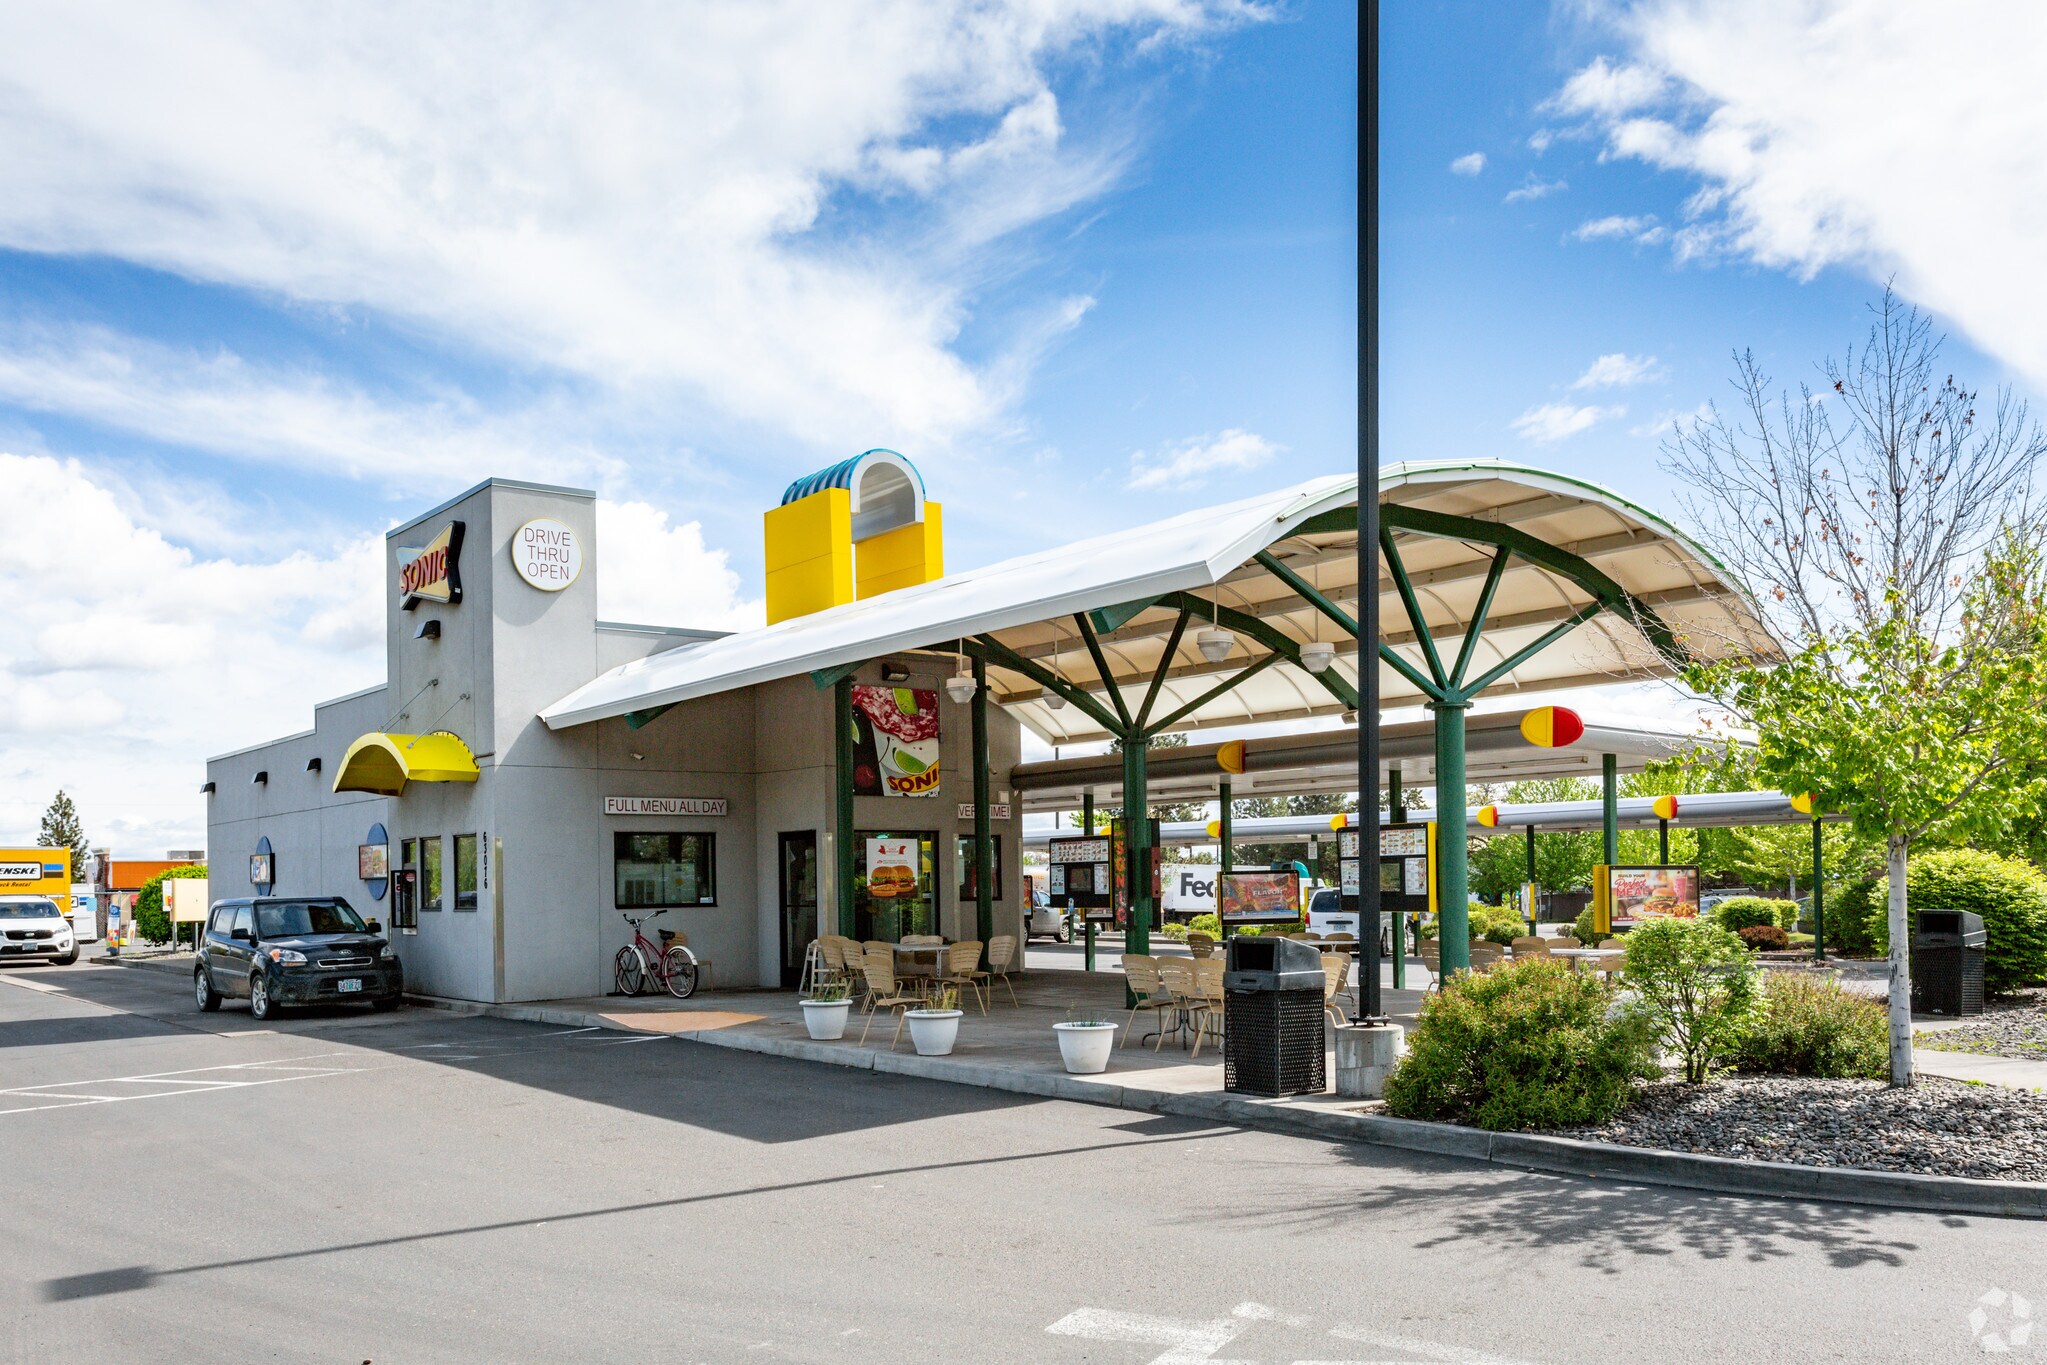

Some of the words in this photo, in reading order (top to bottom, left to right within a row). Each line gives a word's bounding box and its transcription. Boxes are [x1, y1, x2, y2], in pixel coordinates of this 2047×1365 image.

[524, 527, 571, 547] DRIVE
[527, 545, 569, 563] THRU
[399, 546, 449, 597] SONIC
[527, 562, 569, 580] OPEN
[886, 768, 939, 792] SONI
[608, 799, 638, 812] FULL
[640, 799, 677, 813] MENU
[679, 800, 700, 813] ALL
[702, 800, 725, 814] DAY
[990, 806, 1010, 818] IME!
[1115, 840, 1126, 922] SONIC
[1615, 878, 1647, 889] Perfect
[1616, 887, 1649, 896] MEAL
